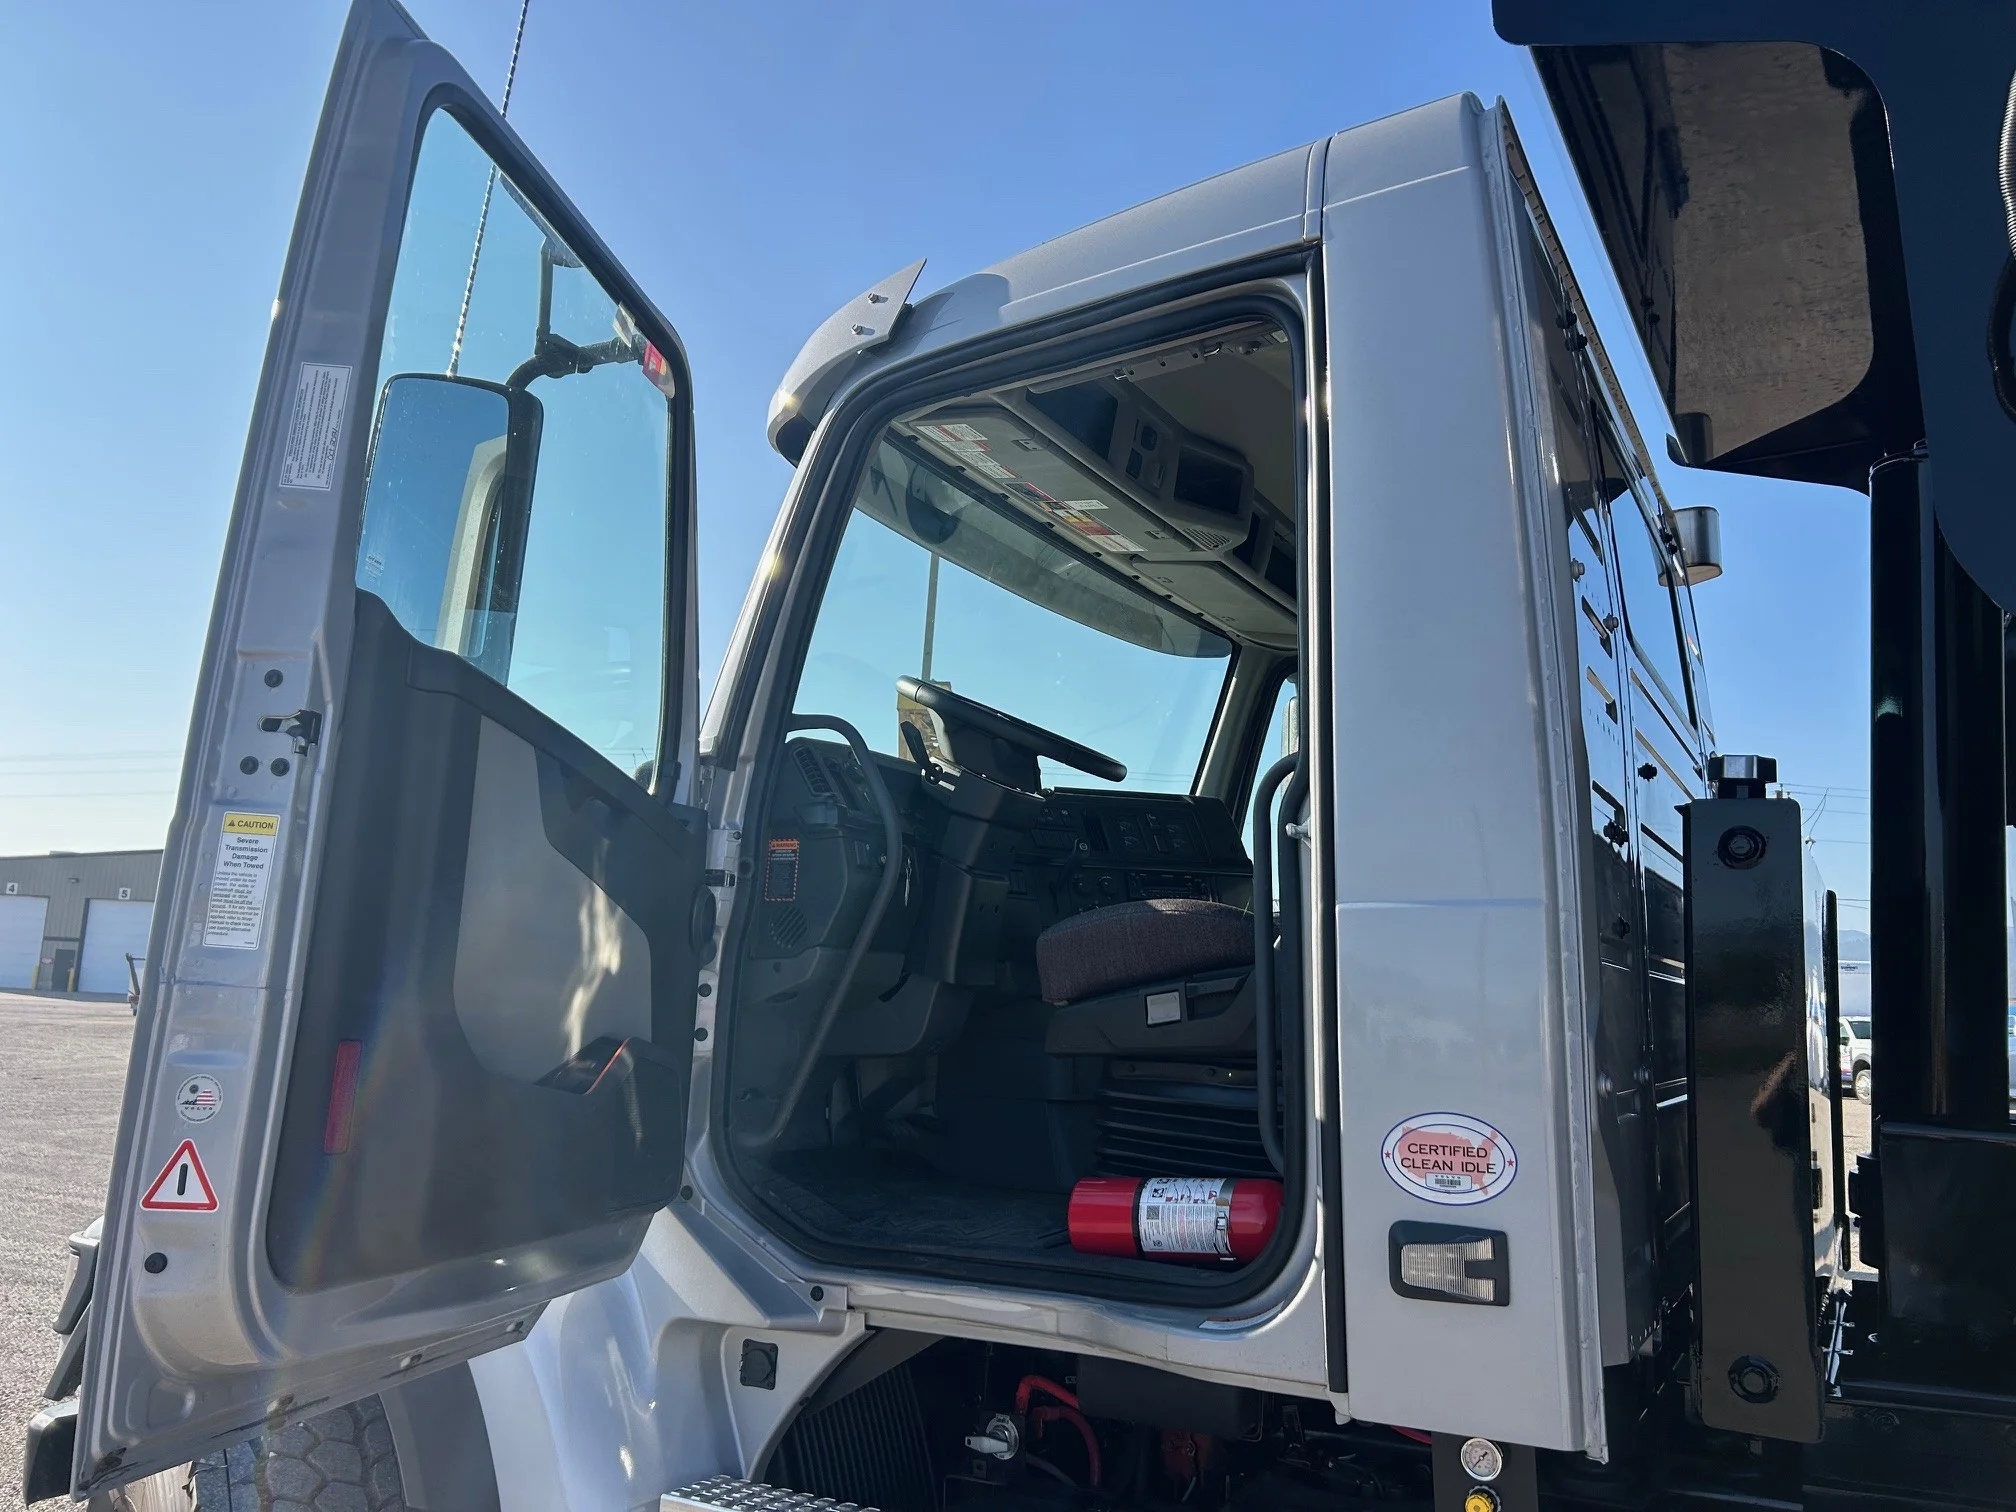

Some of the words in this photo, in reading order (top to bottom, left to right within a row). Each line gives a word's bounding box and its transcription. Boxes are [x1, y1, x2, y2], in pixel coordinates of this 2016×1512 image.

[236, 819, 273, 829] CAUTION
[236, 836, 259, 844] Severe
[224, 844, 268, 853] Transmission
[231, 852, 258, 861] Damage
[242, 861, 264, 869] Towed
[8, 884, 16, 893] 4
[121, 889, 129, 899] 5
[1408, 1143, 1488, 1158] CERTIFIED
[1401, 1158, 1453, 1171] CLEAN
[1462, 1162, 1496, 1174] IDLE
